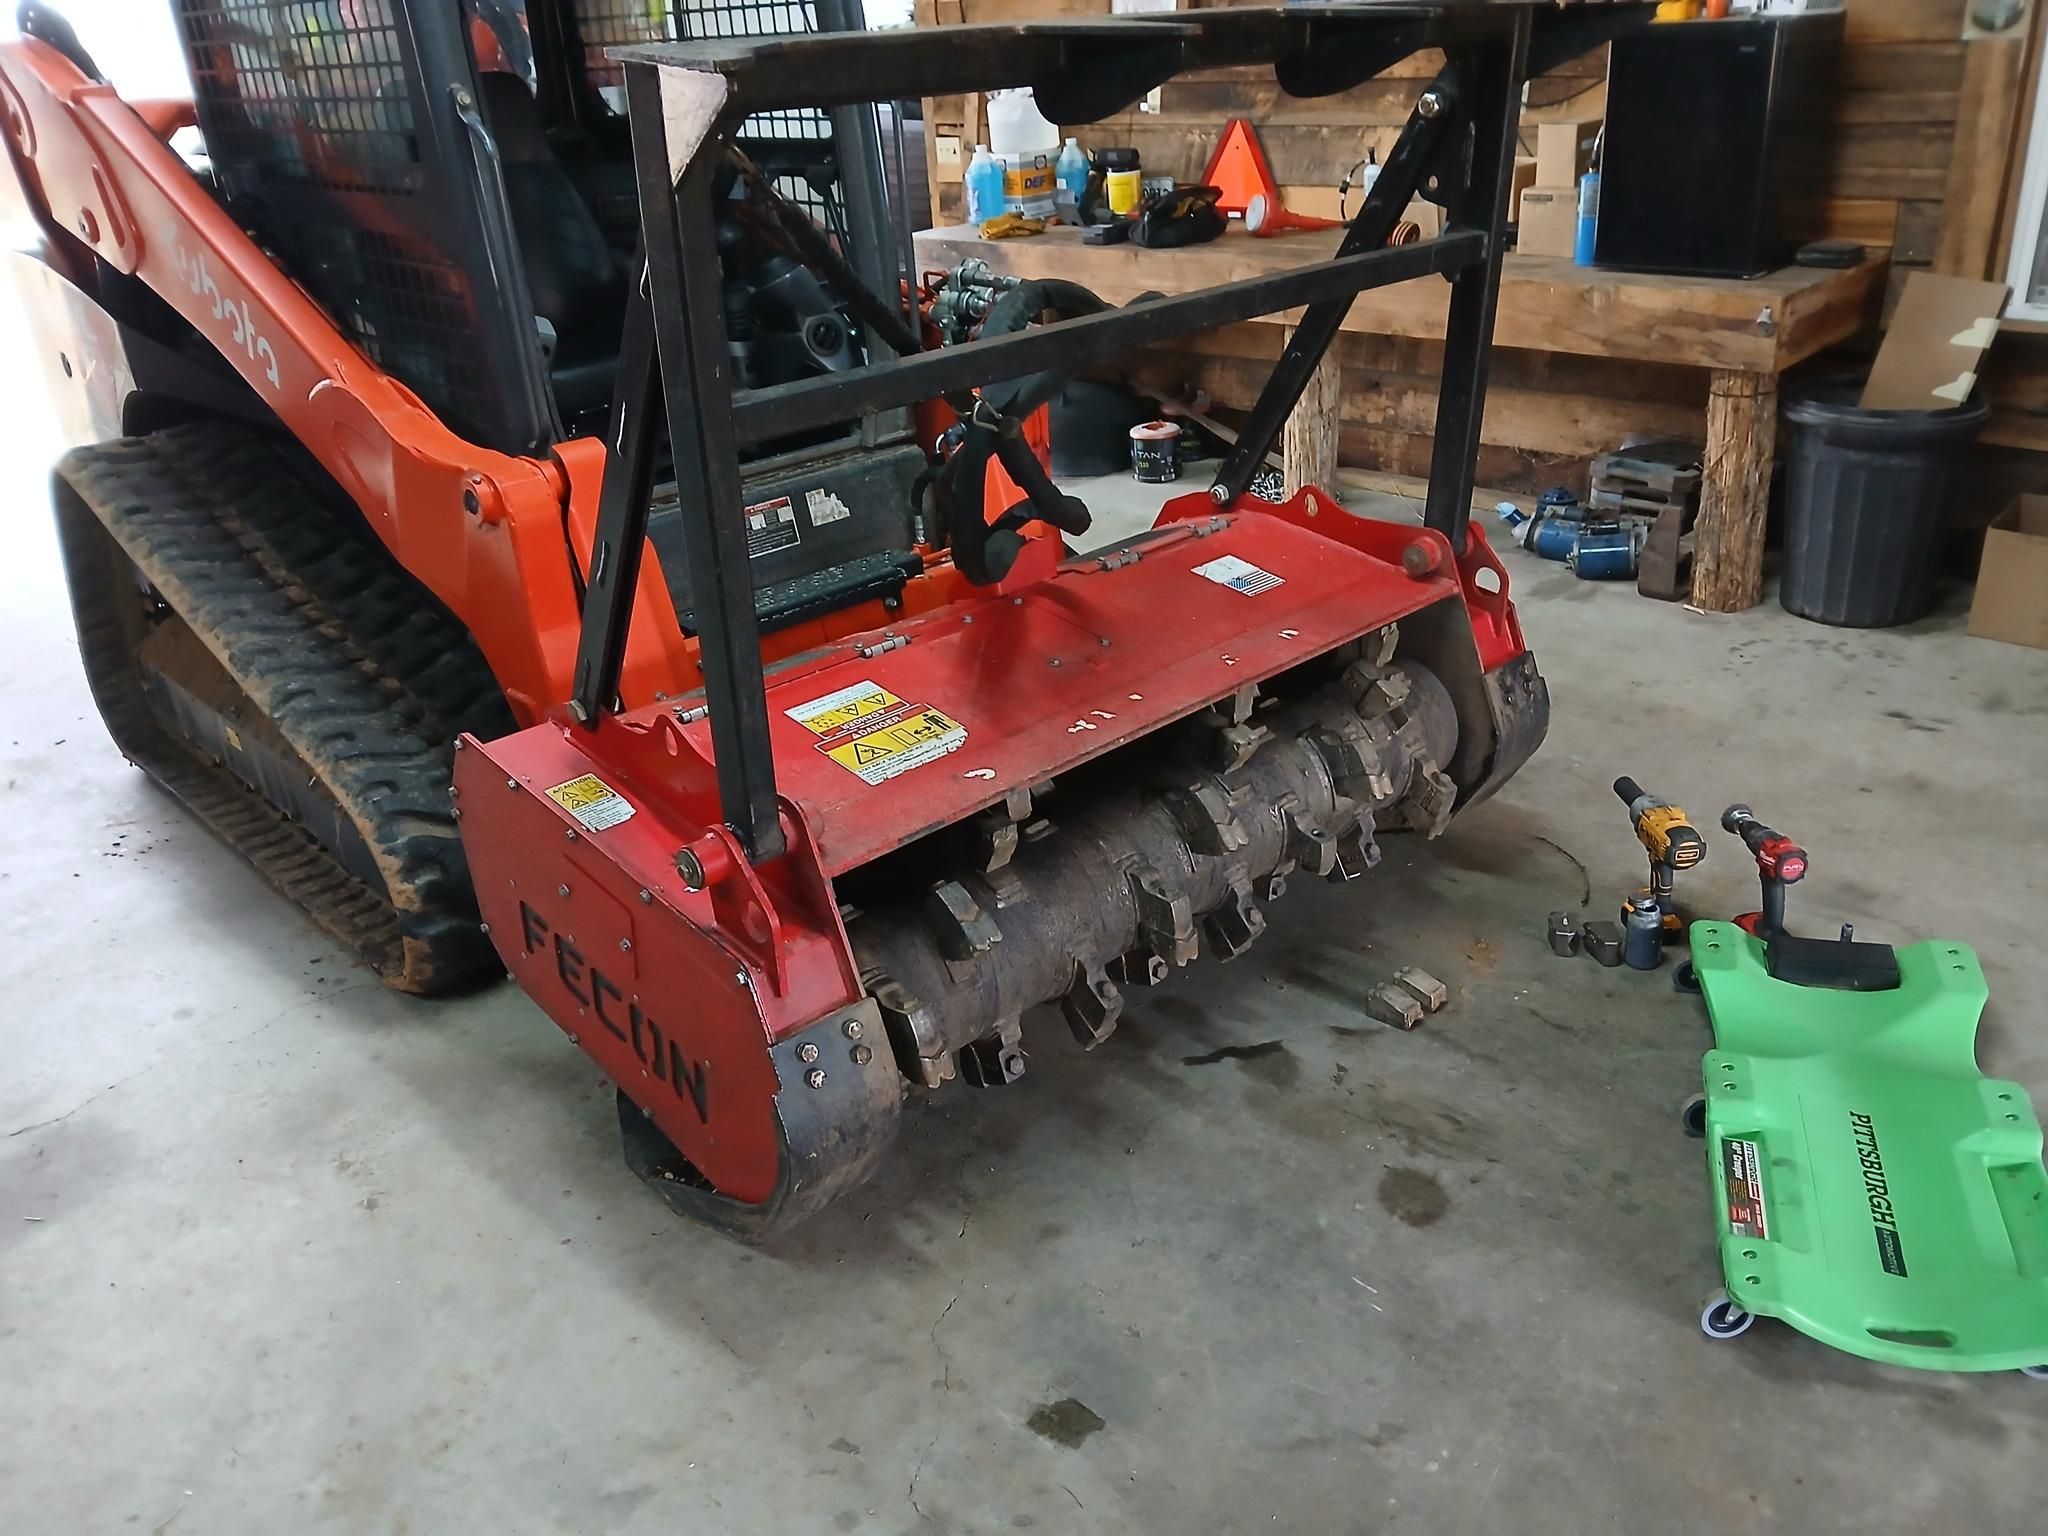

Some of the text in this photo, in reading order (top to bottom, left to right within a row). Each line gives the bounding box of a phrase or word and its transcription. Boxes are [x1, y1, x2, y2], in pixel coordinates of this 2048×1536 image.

[1024, 175, 1047, 190] DEF
[841, 712, 879, 731] DANGER
[860, 716, 902, 736] DANGER
[559, 776, 592, 792] CAUTION
[519, 900, 709, 1124] FECON
[1732, 1154, 1743, 1180] Creeper
[1849, 1110, 1899, 1274] PITTSBURGH AUTOMOTIVE
